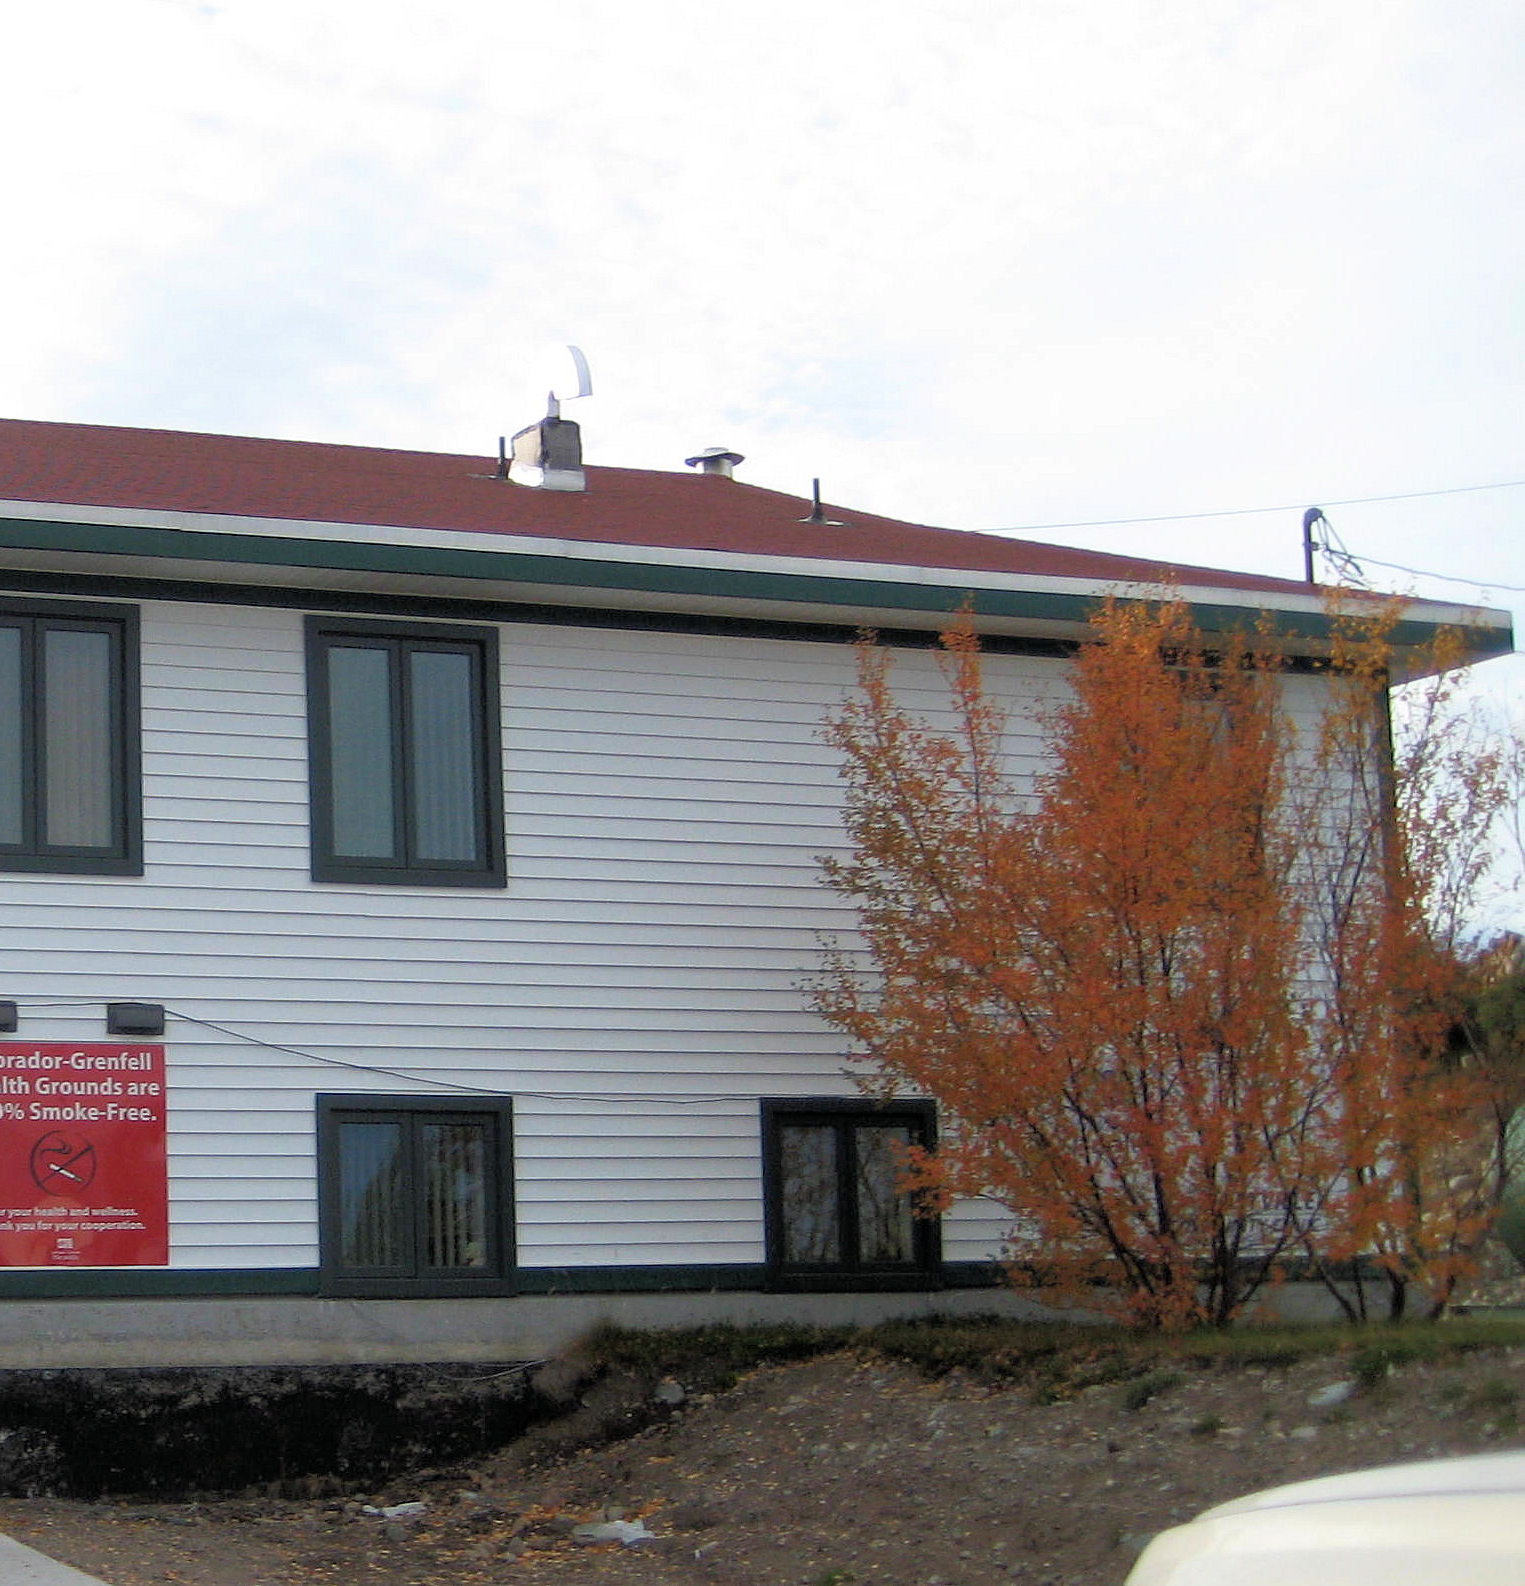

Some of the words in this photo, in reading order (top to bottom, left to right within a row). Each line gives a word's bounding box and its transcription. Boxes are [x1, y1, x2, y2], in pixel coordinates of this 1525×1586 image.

[34, 1076, 123, 1096] Grounds
[127, 1081, 160, 1096] are
[29, 1101, 158, 1122] Smoke-Free.
[8, 1208, 32, 1219] your
[33, 1206, 68, 1217] health
[69, 1206, 90, 1217] and
[91, 1206, 139, 1217] wellness.
[15, 1221, 35, 1233] you
[36, 1220, 53, 1231] for
[54, 1221, 79, 1233] your
[80, 1220, 147, 1233] cooperation.
